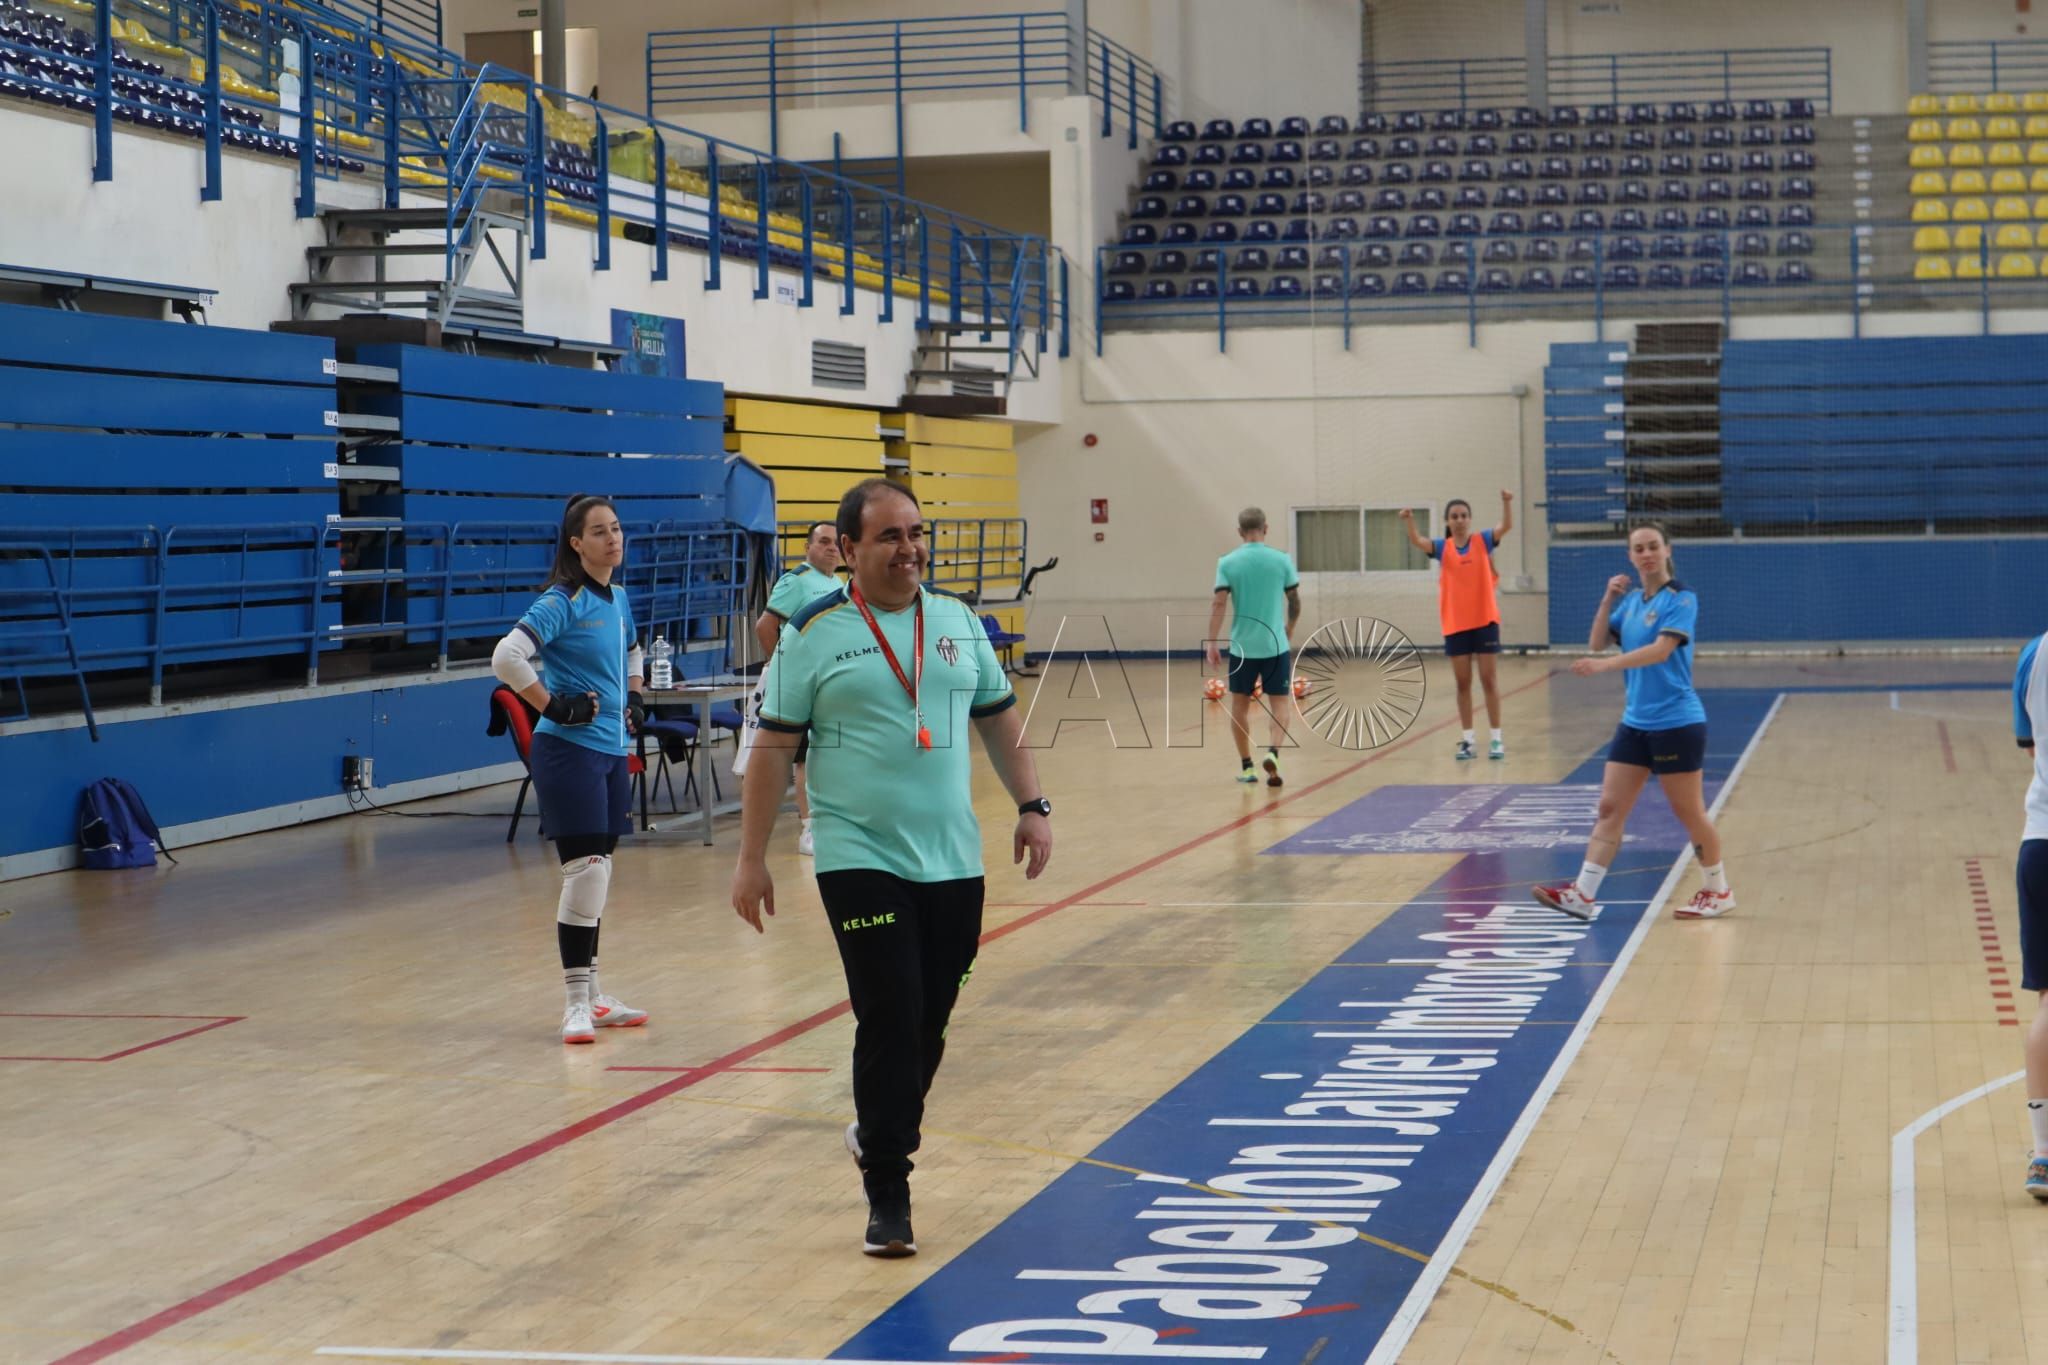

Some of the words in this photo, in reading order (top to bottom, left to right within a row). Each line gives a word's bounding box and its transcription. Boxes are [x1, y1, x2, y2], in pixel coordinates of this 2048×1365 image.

[641, 339, 666, 357] MELILLA
[835, 646, 881, 662] KELME
[842, 912, 896, 932] KELME
[1312, 947, 1576, 1038] Imbroda
[1207, 1043, 1500, 1136] Javier
[948, 1143, 1425, 1360] Pabellón
